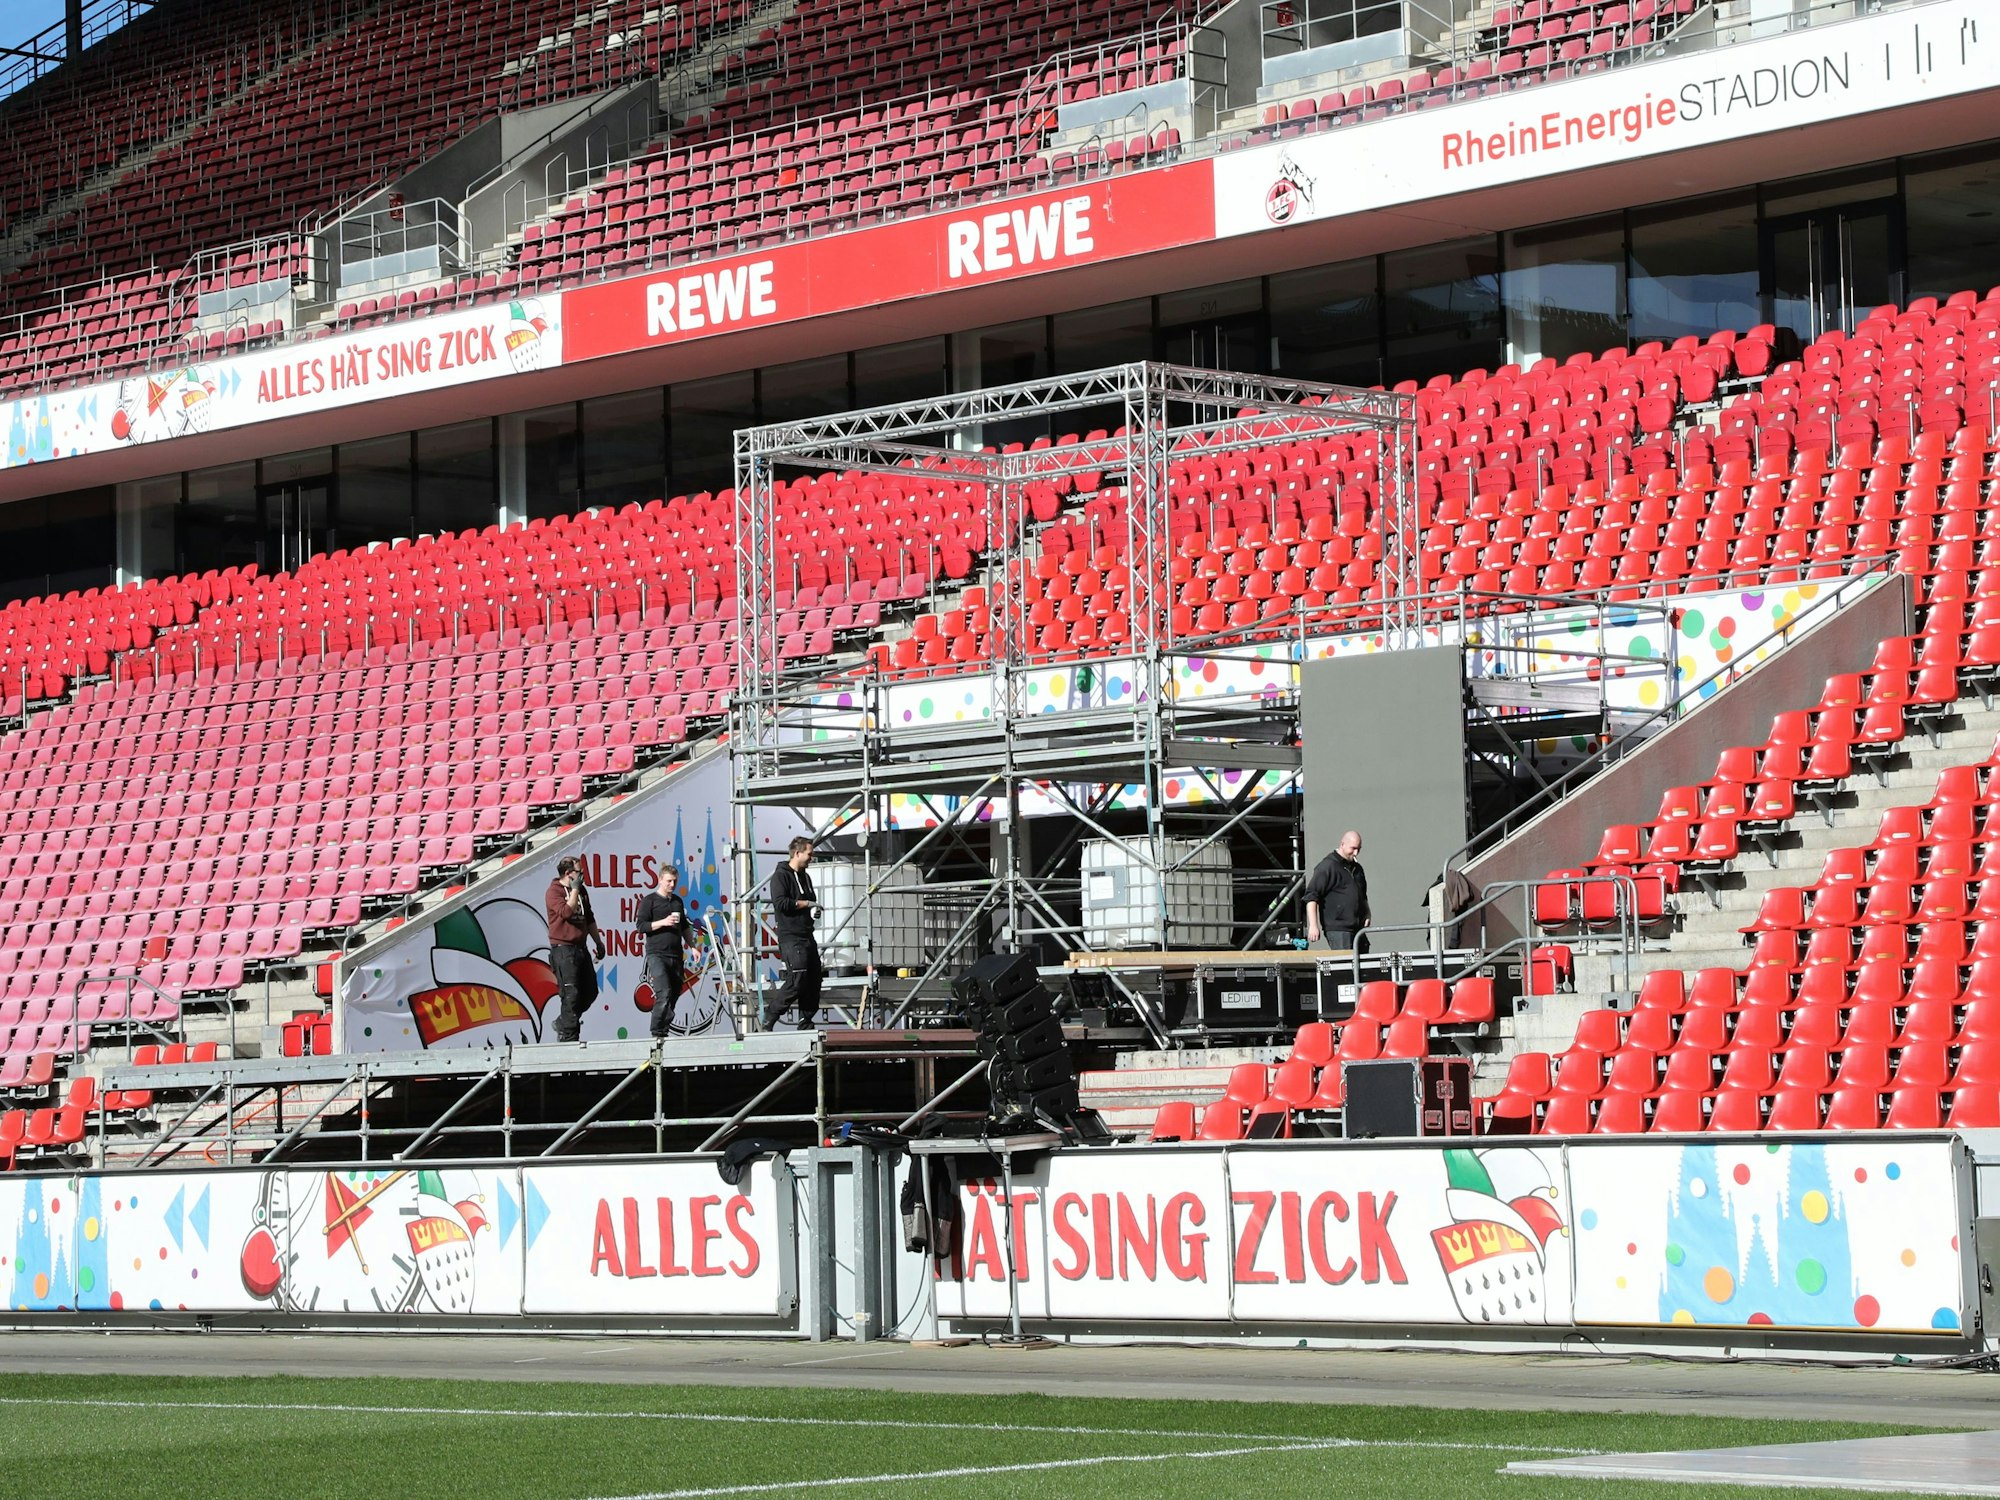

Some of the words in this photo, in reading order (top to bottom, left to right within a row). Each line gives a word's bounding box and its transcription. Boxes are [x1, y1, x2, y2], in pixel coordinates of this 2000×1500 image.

[1443, 51, 1850, 170] RheinEnergieSTADION
[946, 195, 1094, 279] REWE
[646, 260, 777, 337] REWE
[258, 359, 325, 404] ALLES
[331, 344, 373, 391] HÄT
[377, 336, 432, 381] SING
[438, 324, 497, 370] ZICK
[1222, 992, 1260, 1003] LEDium
[1301, 995, 1316, 1004] LED
[1339, 986, 1355, 996] LED
[591, 1194, 760, 1279] ALLES
[1052, 1191, 1209, 1283] SING
[1231, 1190, 1409, 1285] ZICK
